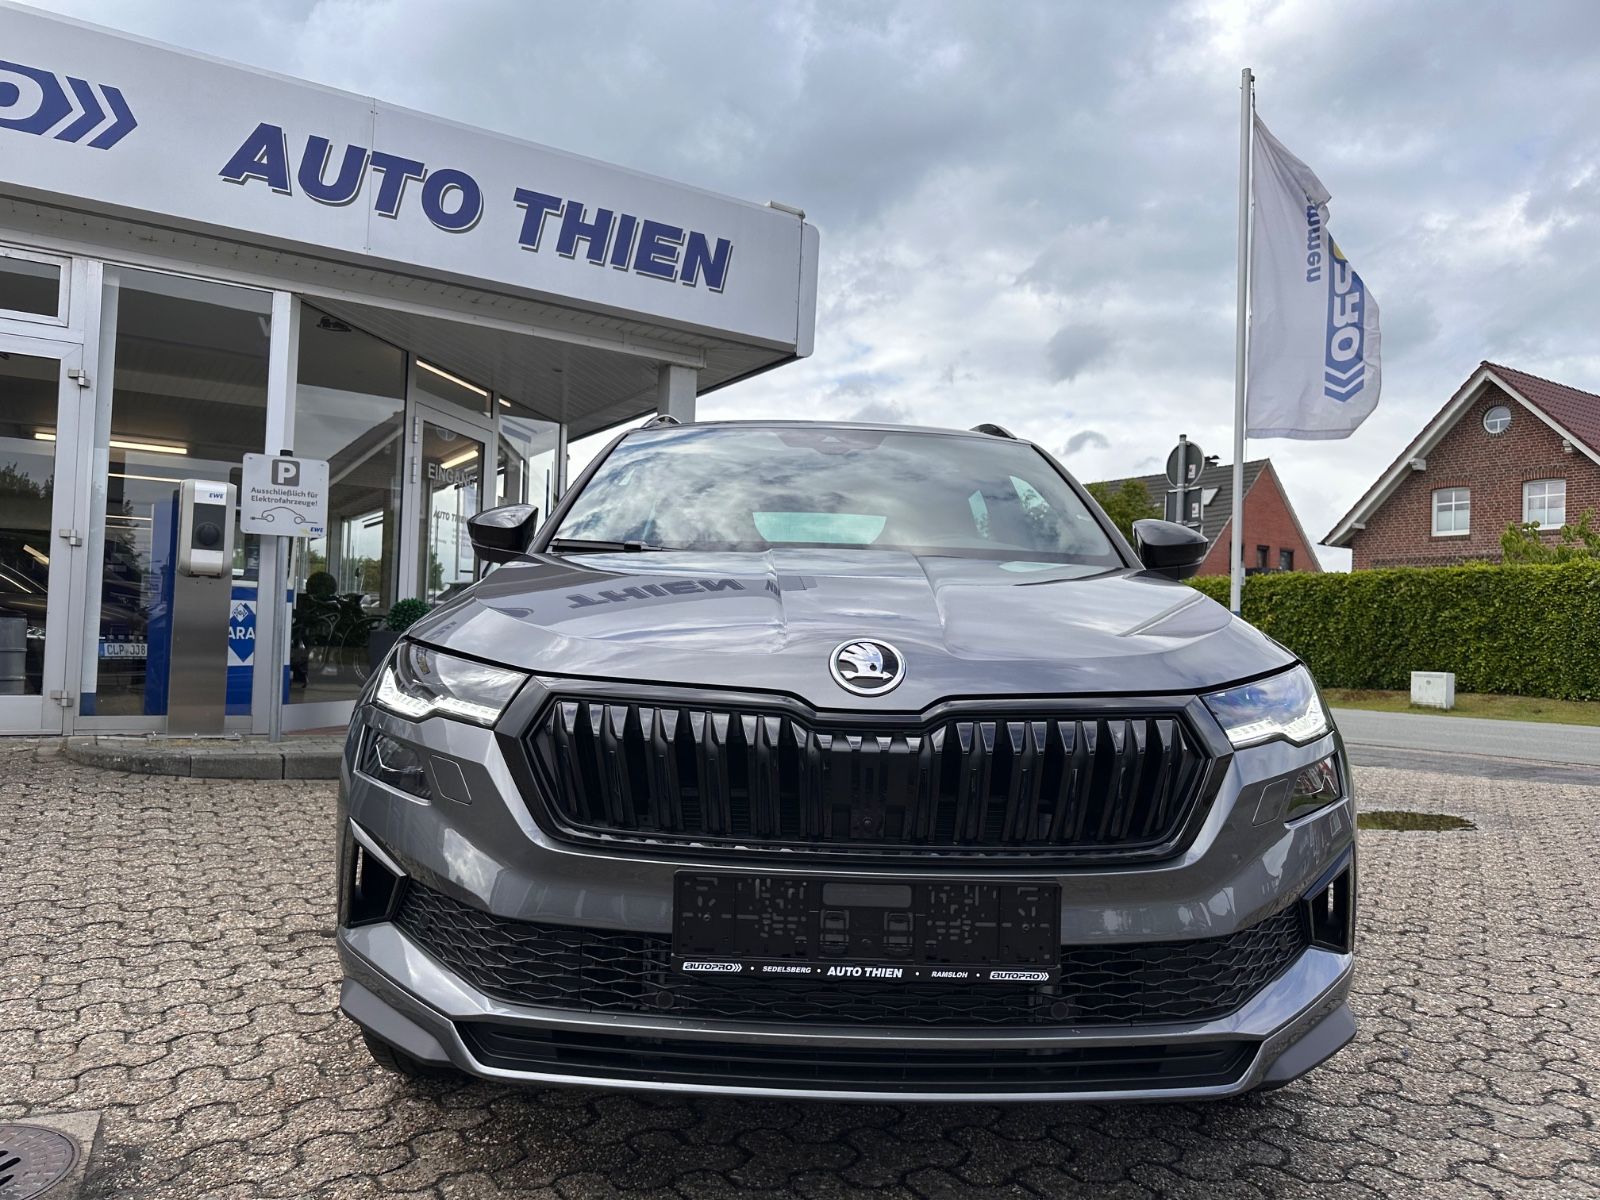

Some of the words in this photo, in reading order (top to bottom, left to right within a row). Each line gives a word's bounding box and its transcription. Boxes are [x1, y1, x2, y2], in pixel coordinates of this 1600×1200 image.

[218, 122, 484, 234] AUTO
[513, 187, 733, 294] THIEN
[277, 461, 297, 484] P
[250, 487, 306, 498] Ausschließlich
[250, 495, 318, 508] Elektrofahrzeuge!
[106, 644, 125, 656] CLP
[762, 965, 812, 974] SEDELSBERG
[827, 966, 862, 977] AUTO
[864, 967, 903, 978] THIEN
[931, 970, 969, 979] RAMSLOH
